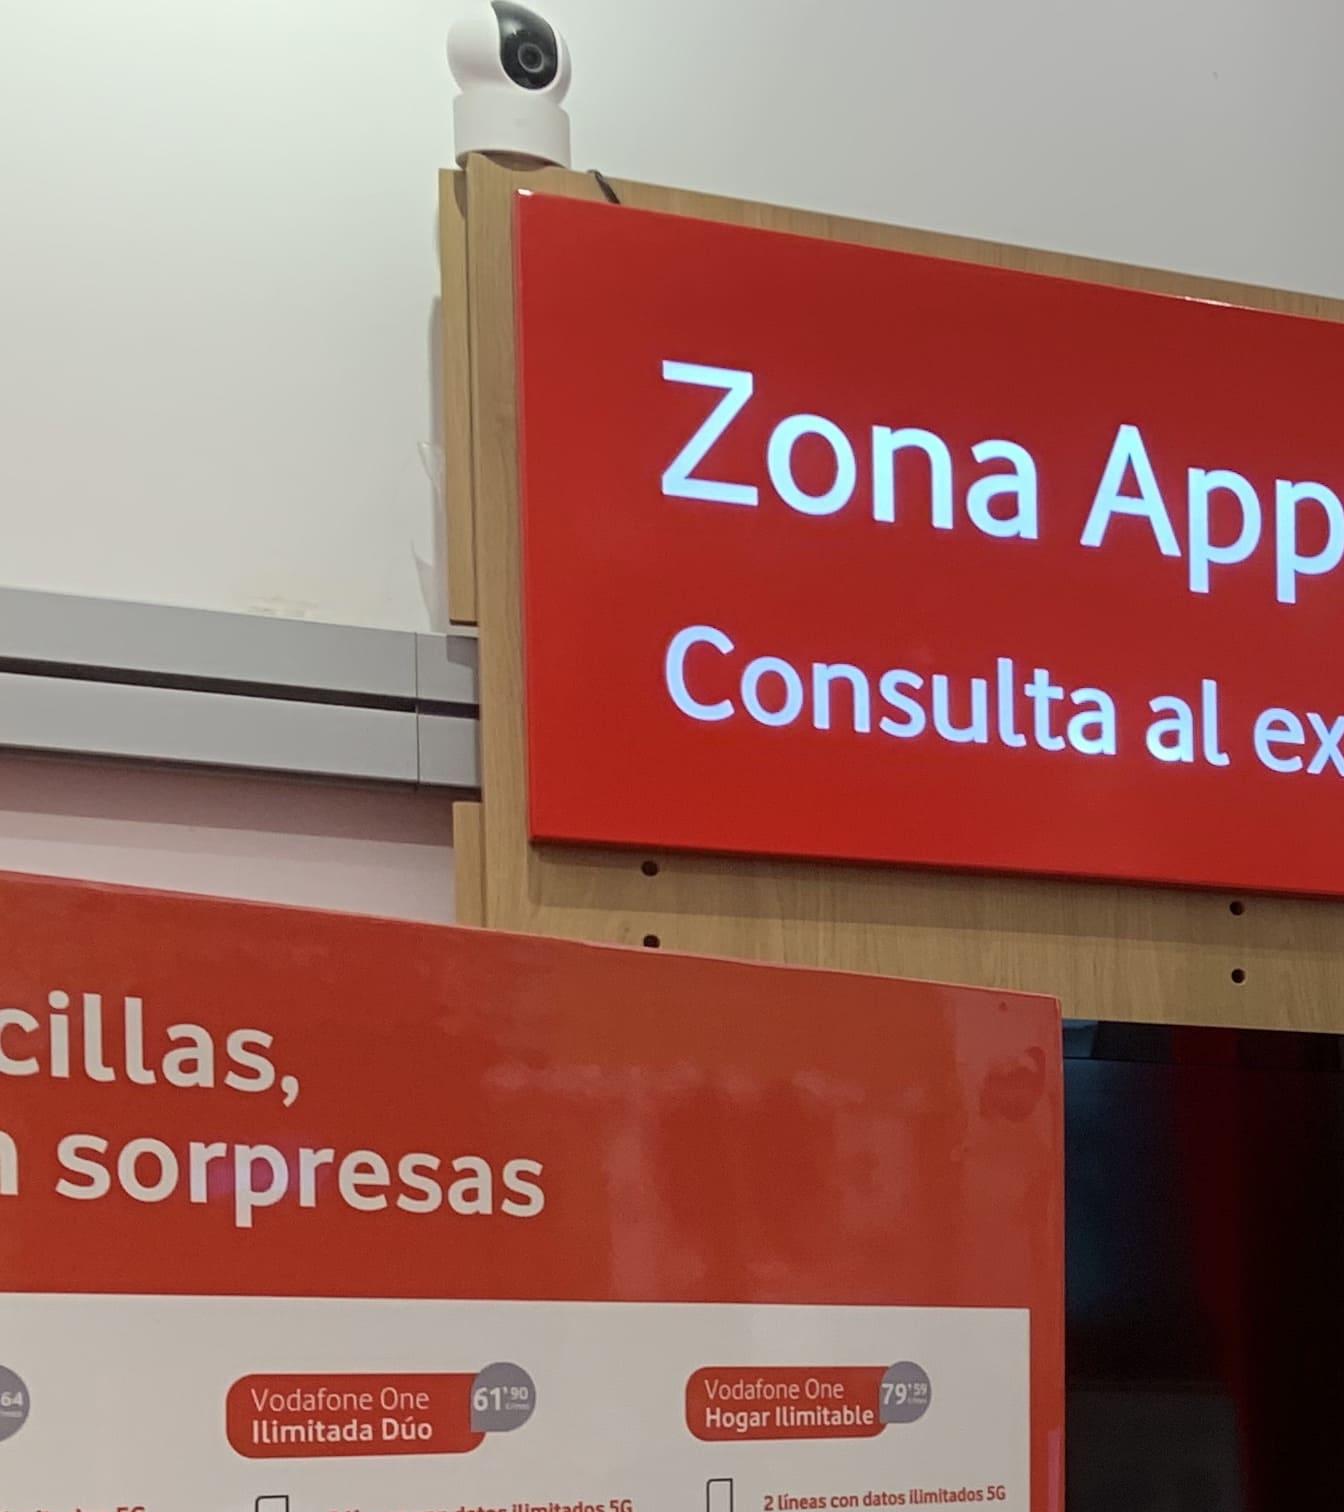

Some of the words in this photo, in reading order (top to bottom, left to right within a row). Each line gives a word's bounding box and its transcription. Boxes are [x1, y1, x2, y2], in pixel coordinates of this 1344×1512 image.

[661, 360, 1039, 540] Zona
[664, 624, 1118, 758] Consulta
[1147, 678, 1228, 767] al
[0, 989, 302, 1107] cillas,
[56, 1131, 546, 1228] sorpresas
[251, 1386, 373, 1412] Vodafone
[380, 1386, 430, 1411] One
[704, 1378, 800, 1401] Vodafone
[805, 1377, 844, 1399] One
[252, 1418, 373, 1444] Ilimitada
[381, 1416, 433, 1442] Dúo
[705, 1407, 771, 1433] Hogar
[775, 1404, 874, 1427] Ilimitable
[763, 1496, 774, 1511] 2
[778, 1492, 827, 1510] líneas
[830, 1493, 859, 1508] con
[863, 1489, 906, 1507] datos
[909, 1486, 984, 1505] ilimitados
[986, 1485, 1006, 1500] 5G
